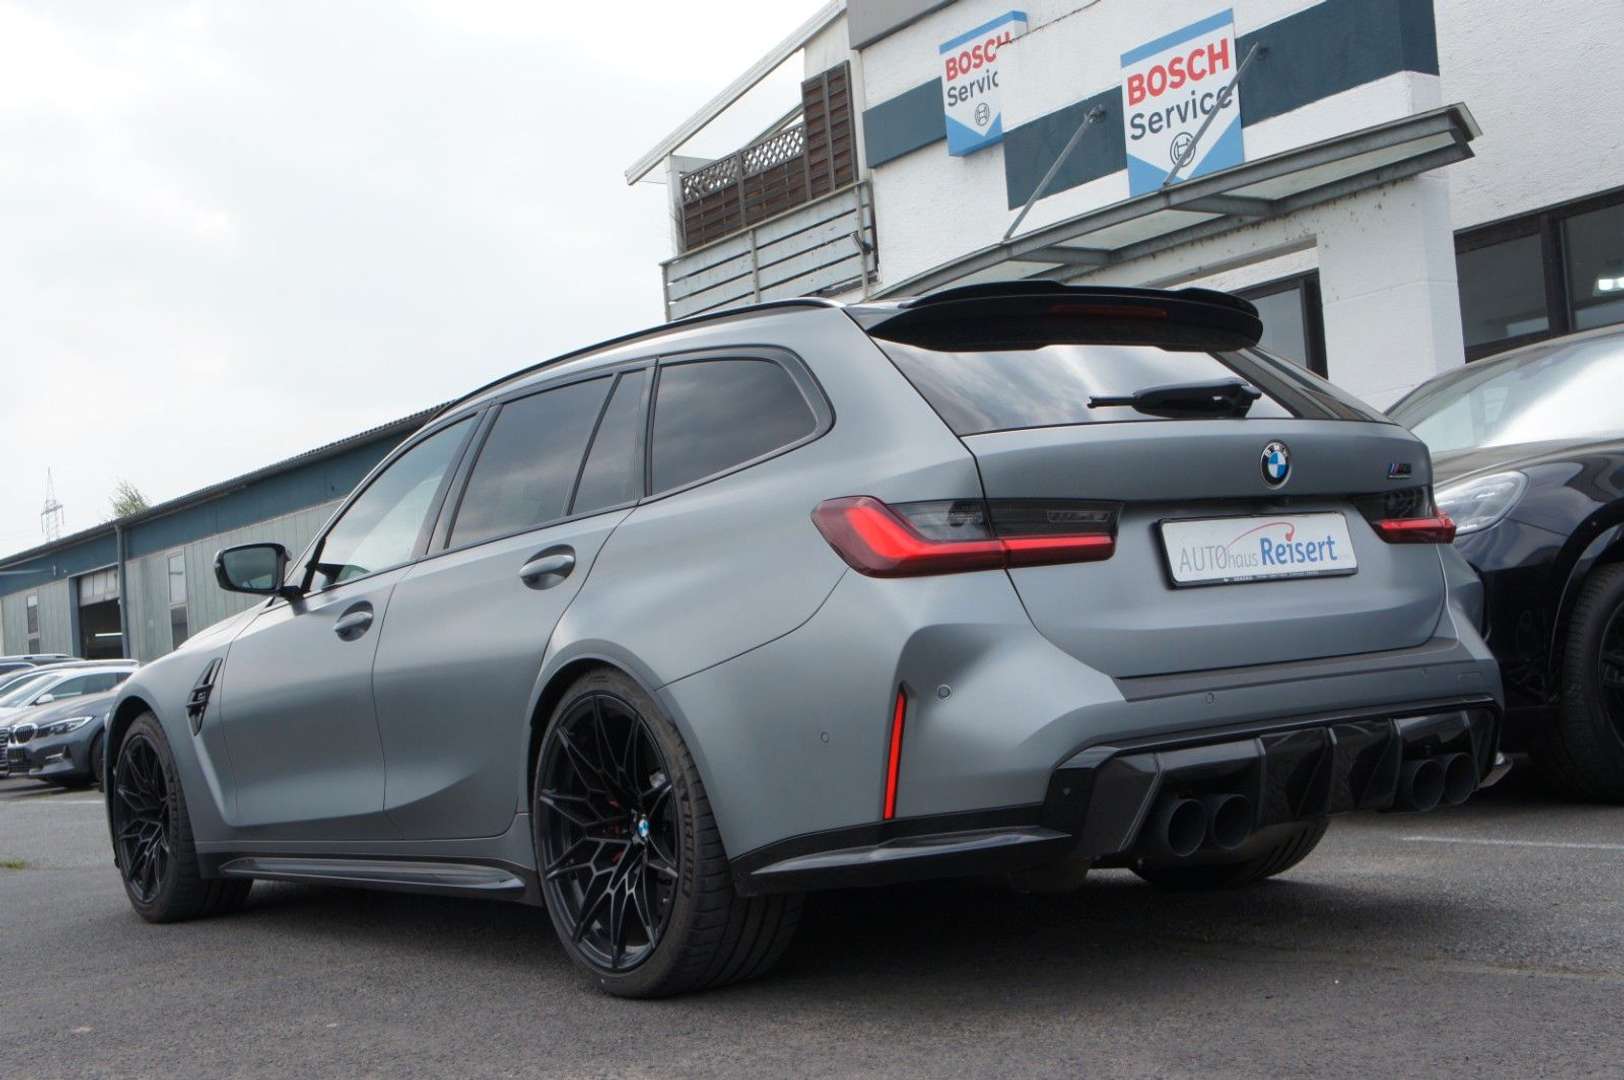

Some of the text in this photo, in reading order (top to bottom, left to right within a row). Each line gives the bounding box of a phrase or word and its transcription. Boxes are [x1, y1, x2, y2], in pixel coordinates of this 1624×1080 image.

[947, 69, 999, 107] Servic
[1127, 38, 1229, 106] BOSCH
[1130, 86, 1233, 140] Service
[1259, 535, 1338, 565] Reisert
